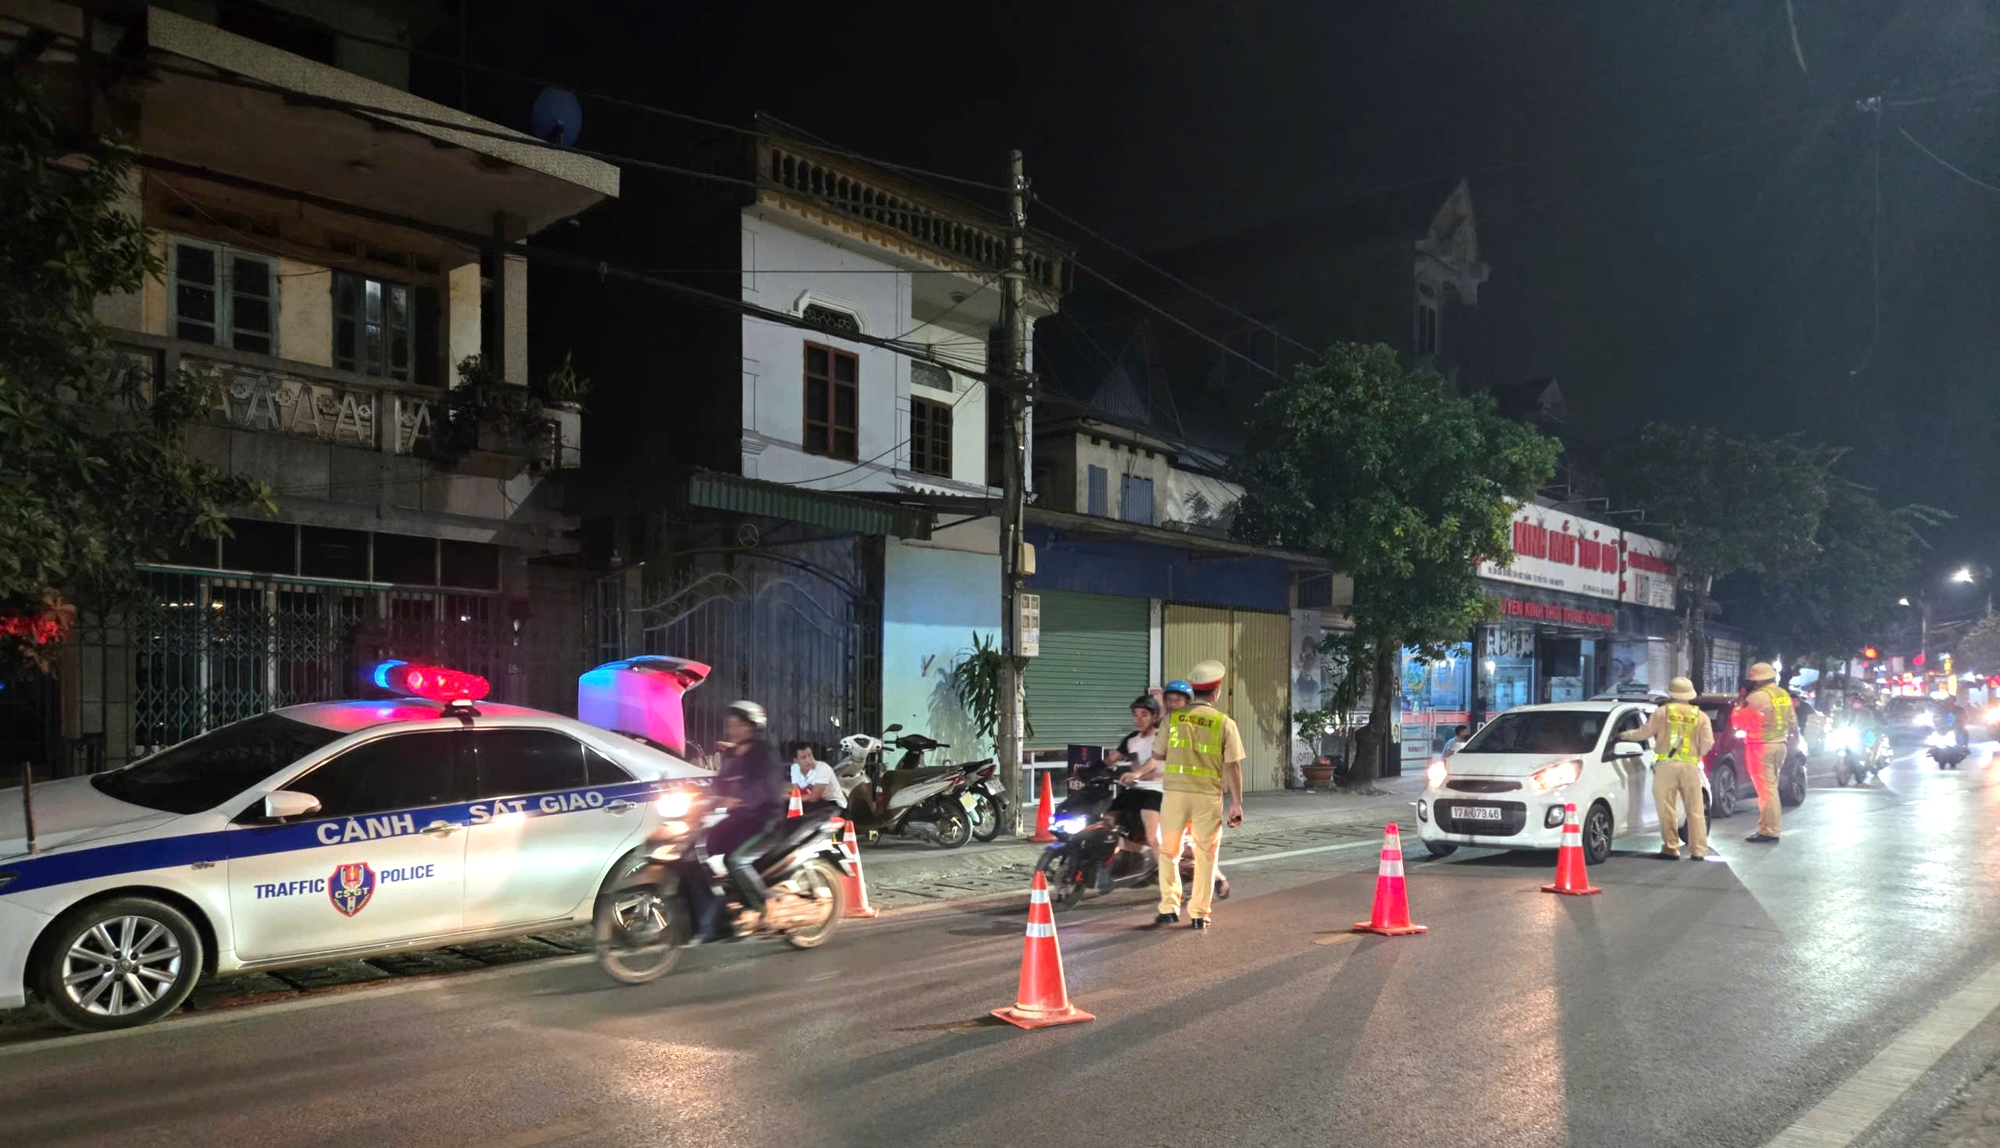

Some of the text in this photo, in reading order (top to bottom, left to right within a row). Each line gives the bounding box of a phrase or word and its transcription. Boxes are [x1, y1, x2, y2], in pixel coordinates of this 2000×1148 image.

[1513, 516, 1547, 559] KÍNH
[1548, 520, 1576, 565] MẮT
[1577, 530, 1601, 571] THỦ
[1179, 715, 1214, 727] C.S.G.T
[317, 791, 604, 845] CẢNH SÁT GIAO
[255, 864, 435, 899] TRAFFIC POLICE
